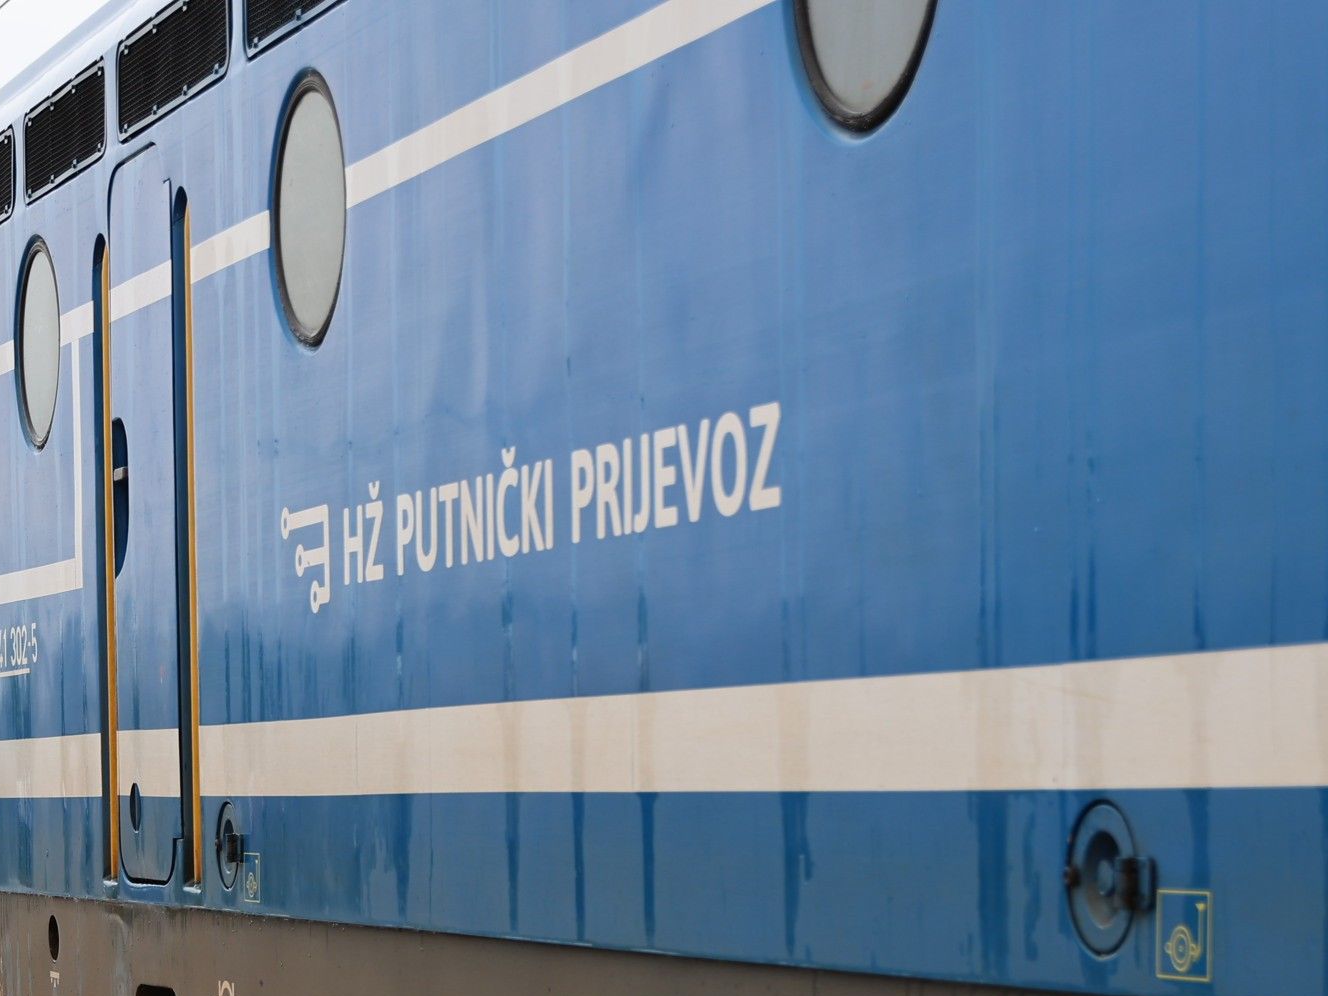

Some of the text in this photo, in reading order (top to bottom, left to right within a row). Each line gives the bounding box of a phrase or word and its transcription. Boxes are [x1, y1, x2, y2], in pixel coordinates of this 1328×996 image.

[343, 401, 782, 585] HŽ PUTNIČKI PRIJEVOZ
[10, 623, 38, 666] 302-5
